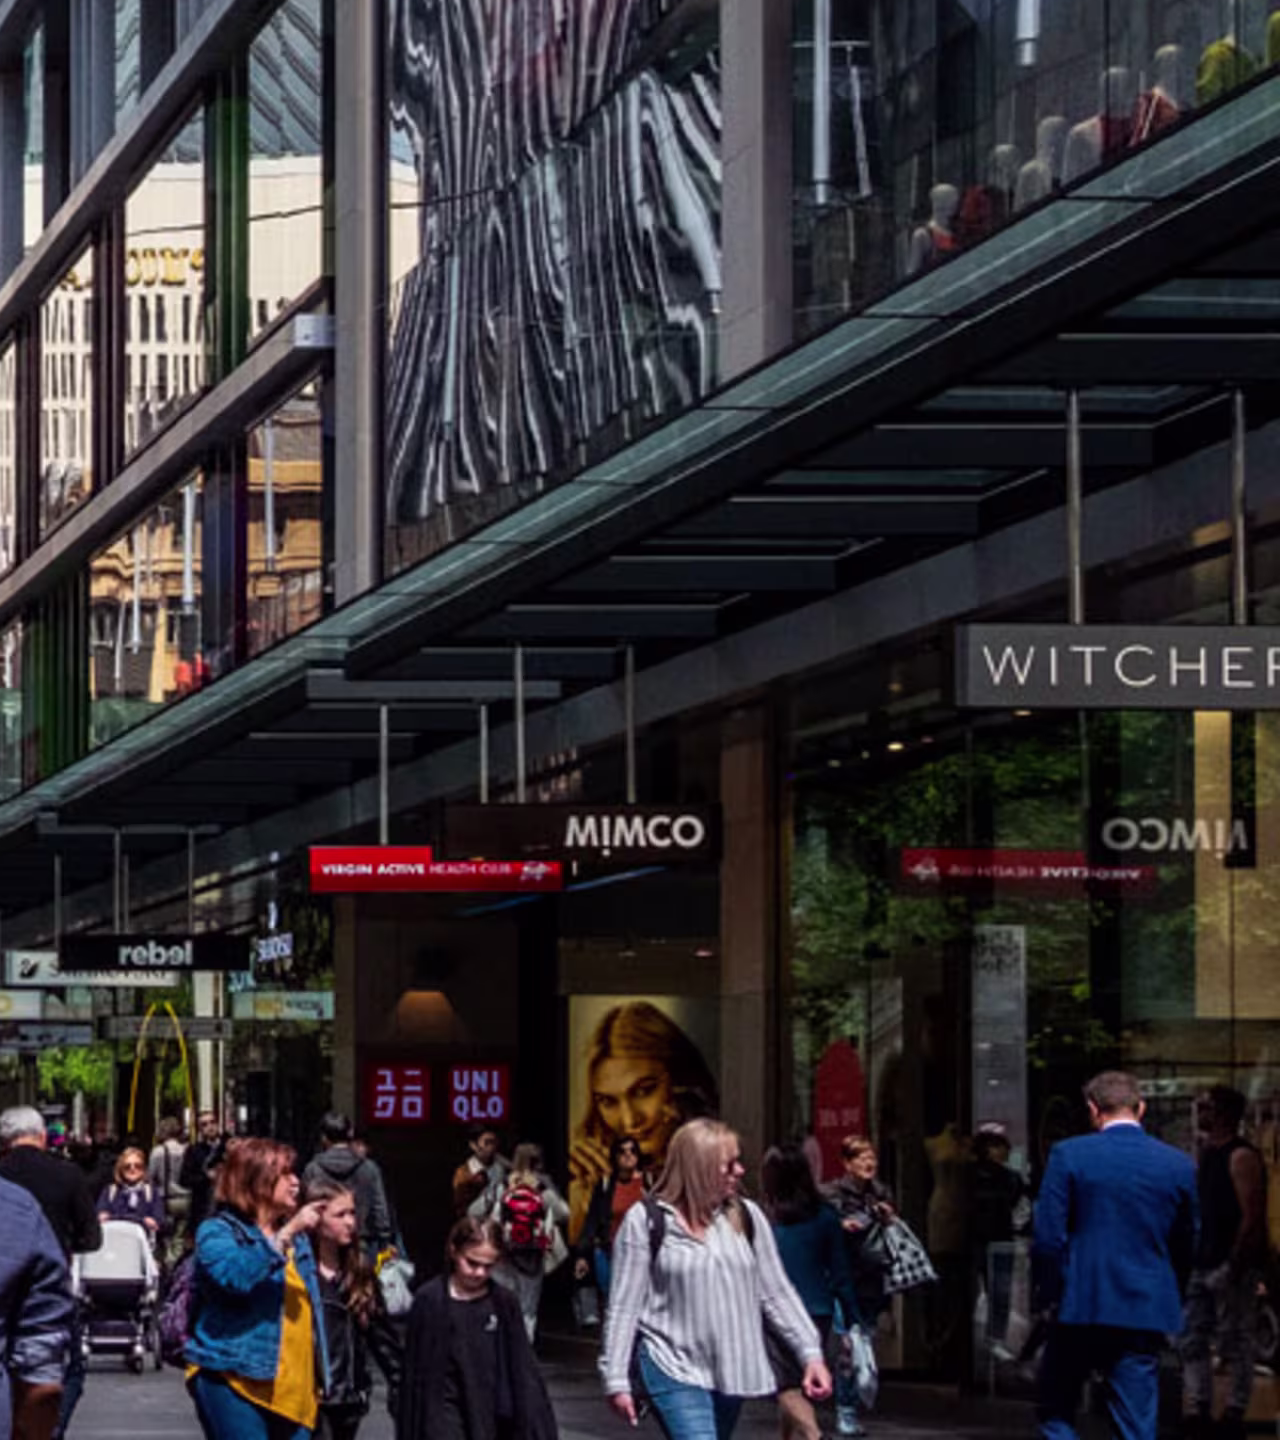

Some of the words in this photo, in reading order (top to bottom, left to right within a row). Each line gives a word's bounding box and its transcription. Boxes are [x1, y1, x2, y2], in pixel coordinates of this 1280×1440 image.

[119, 940, 194, 967] rebel
[452, 1070, 500, 1093] UNI
[452, 1095, 505, 1121] QLO
